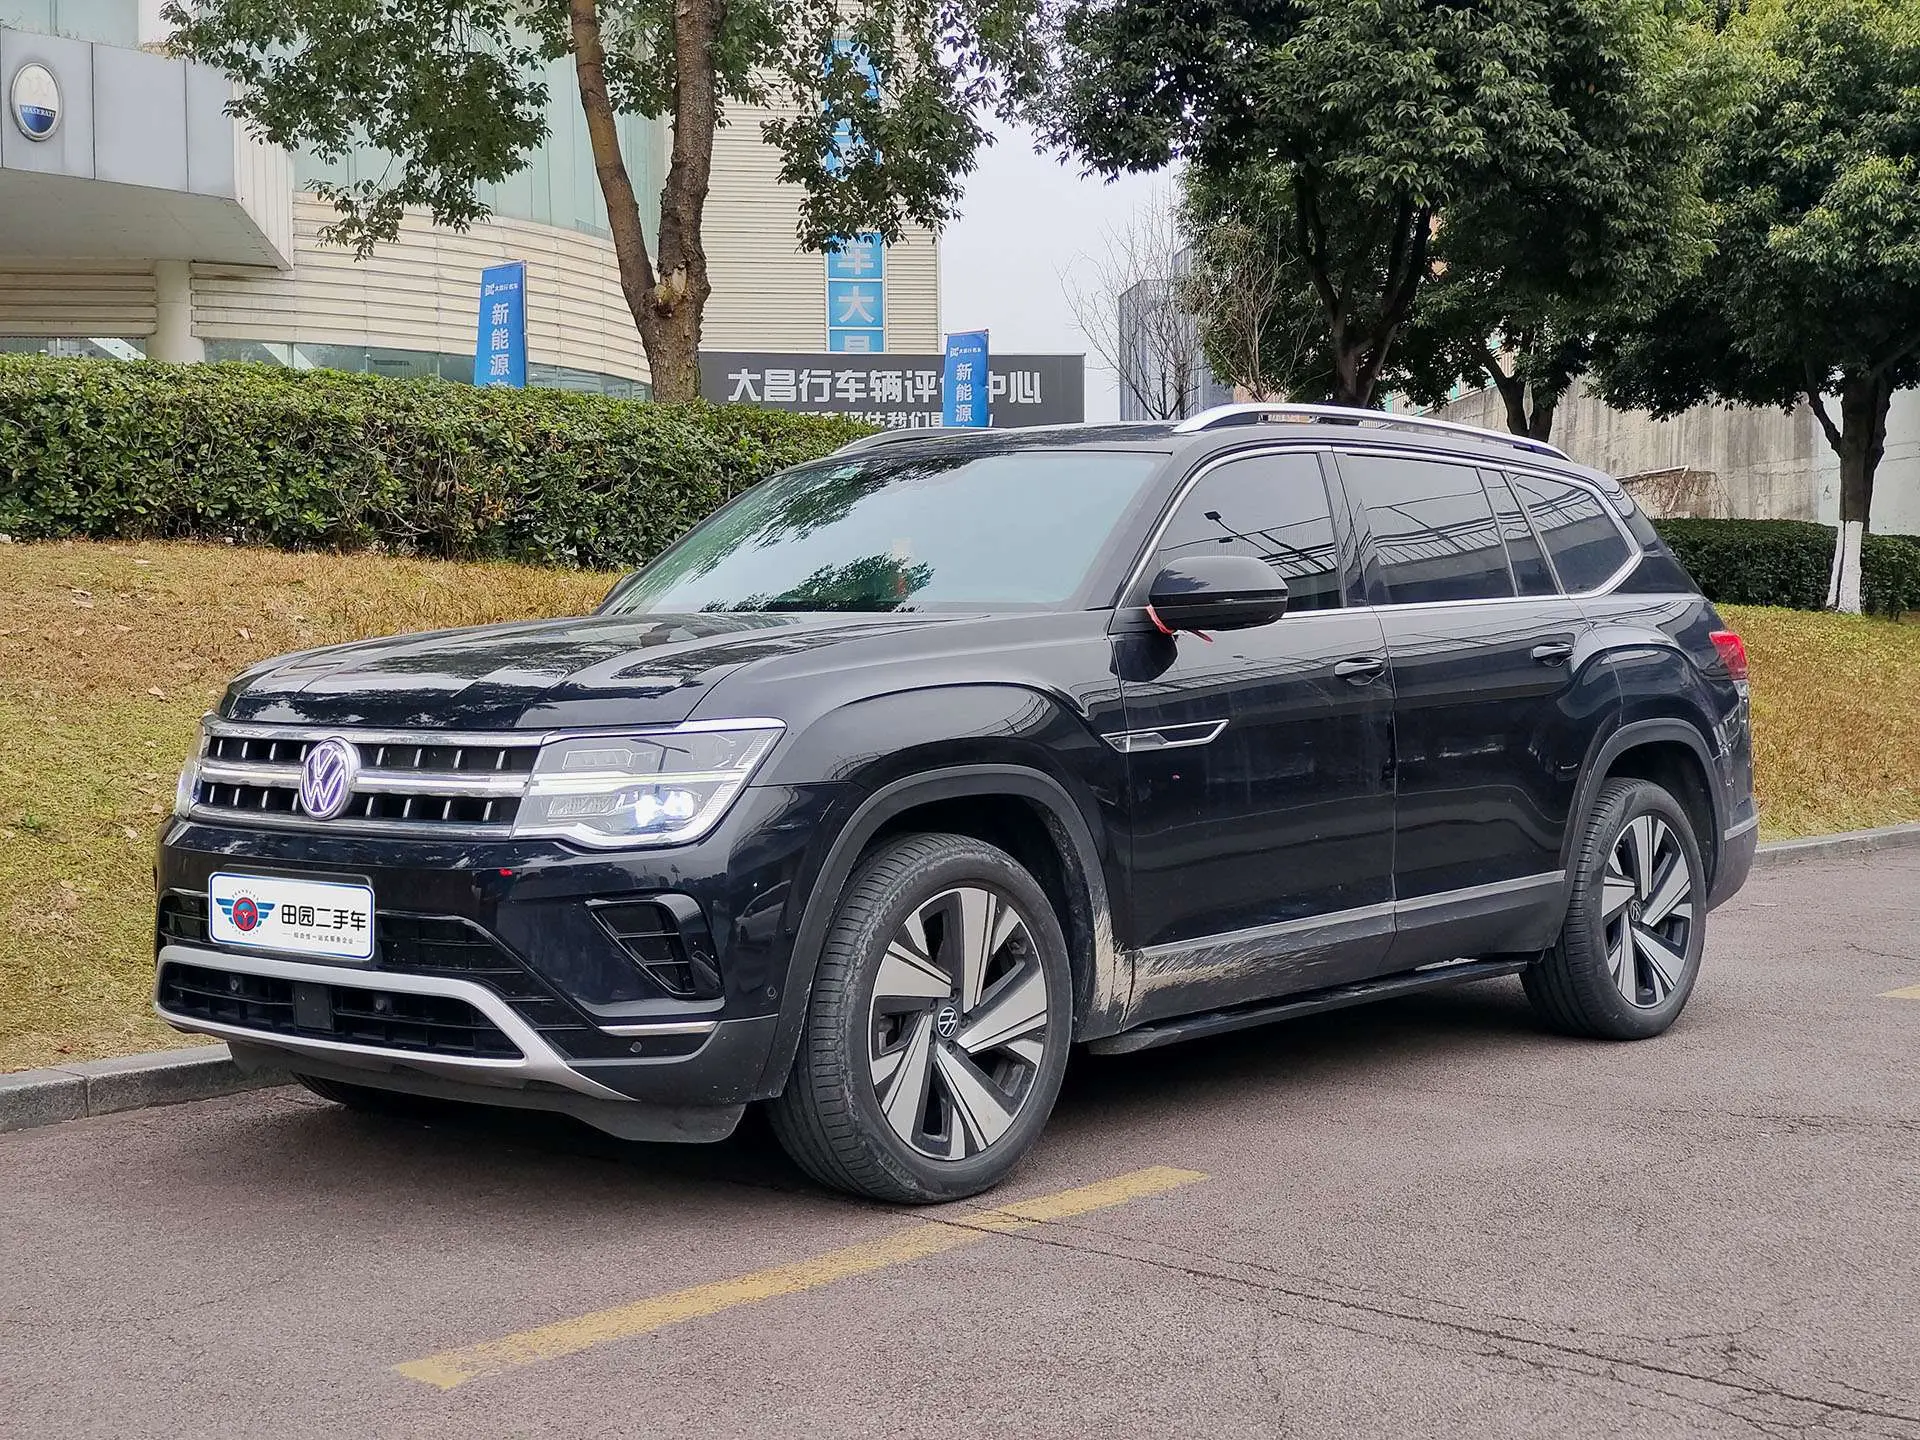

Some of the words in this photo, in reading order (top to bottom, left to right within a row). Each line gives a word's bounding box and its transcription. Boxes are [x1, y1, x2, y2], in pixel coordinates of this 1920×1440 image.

[489, 303, 511, 387] 新能源
[728, 368, 1041, 404] 大昌行车辆评中心
[956, 363, 973, 427] 新能源
[281, 904, 367, 931] 田园二手车
